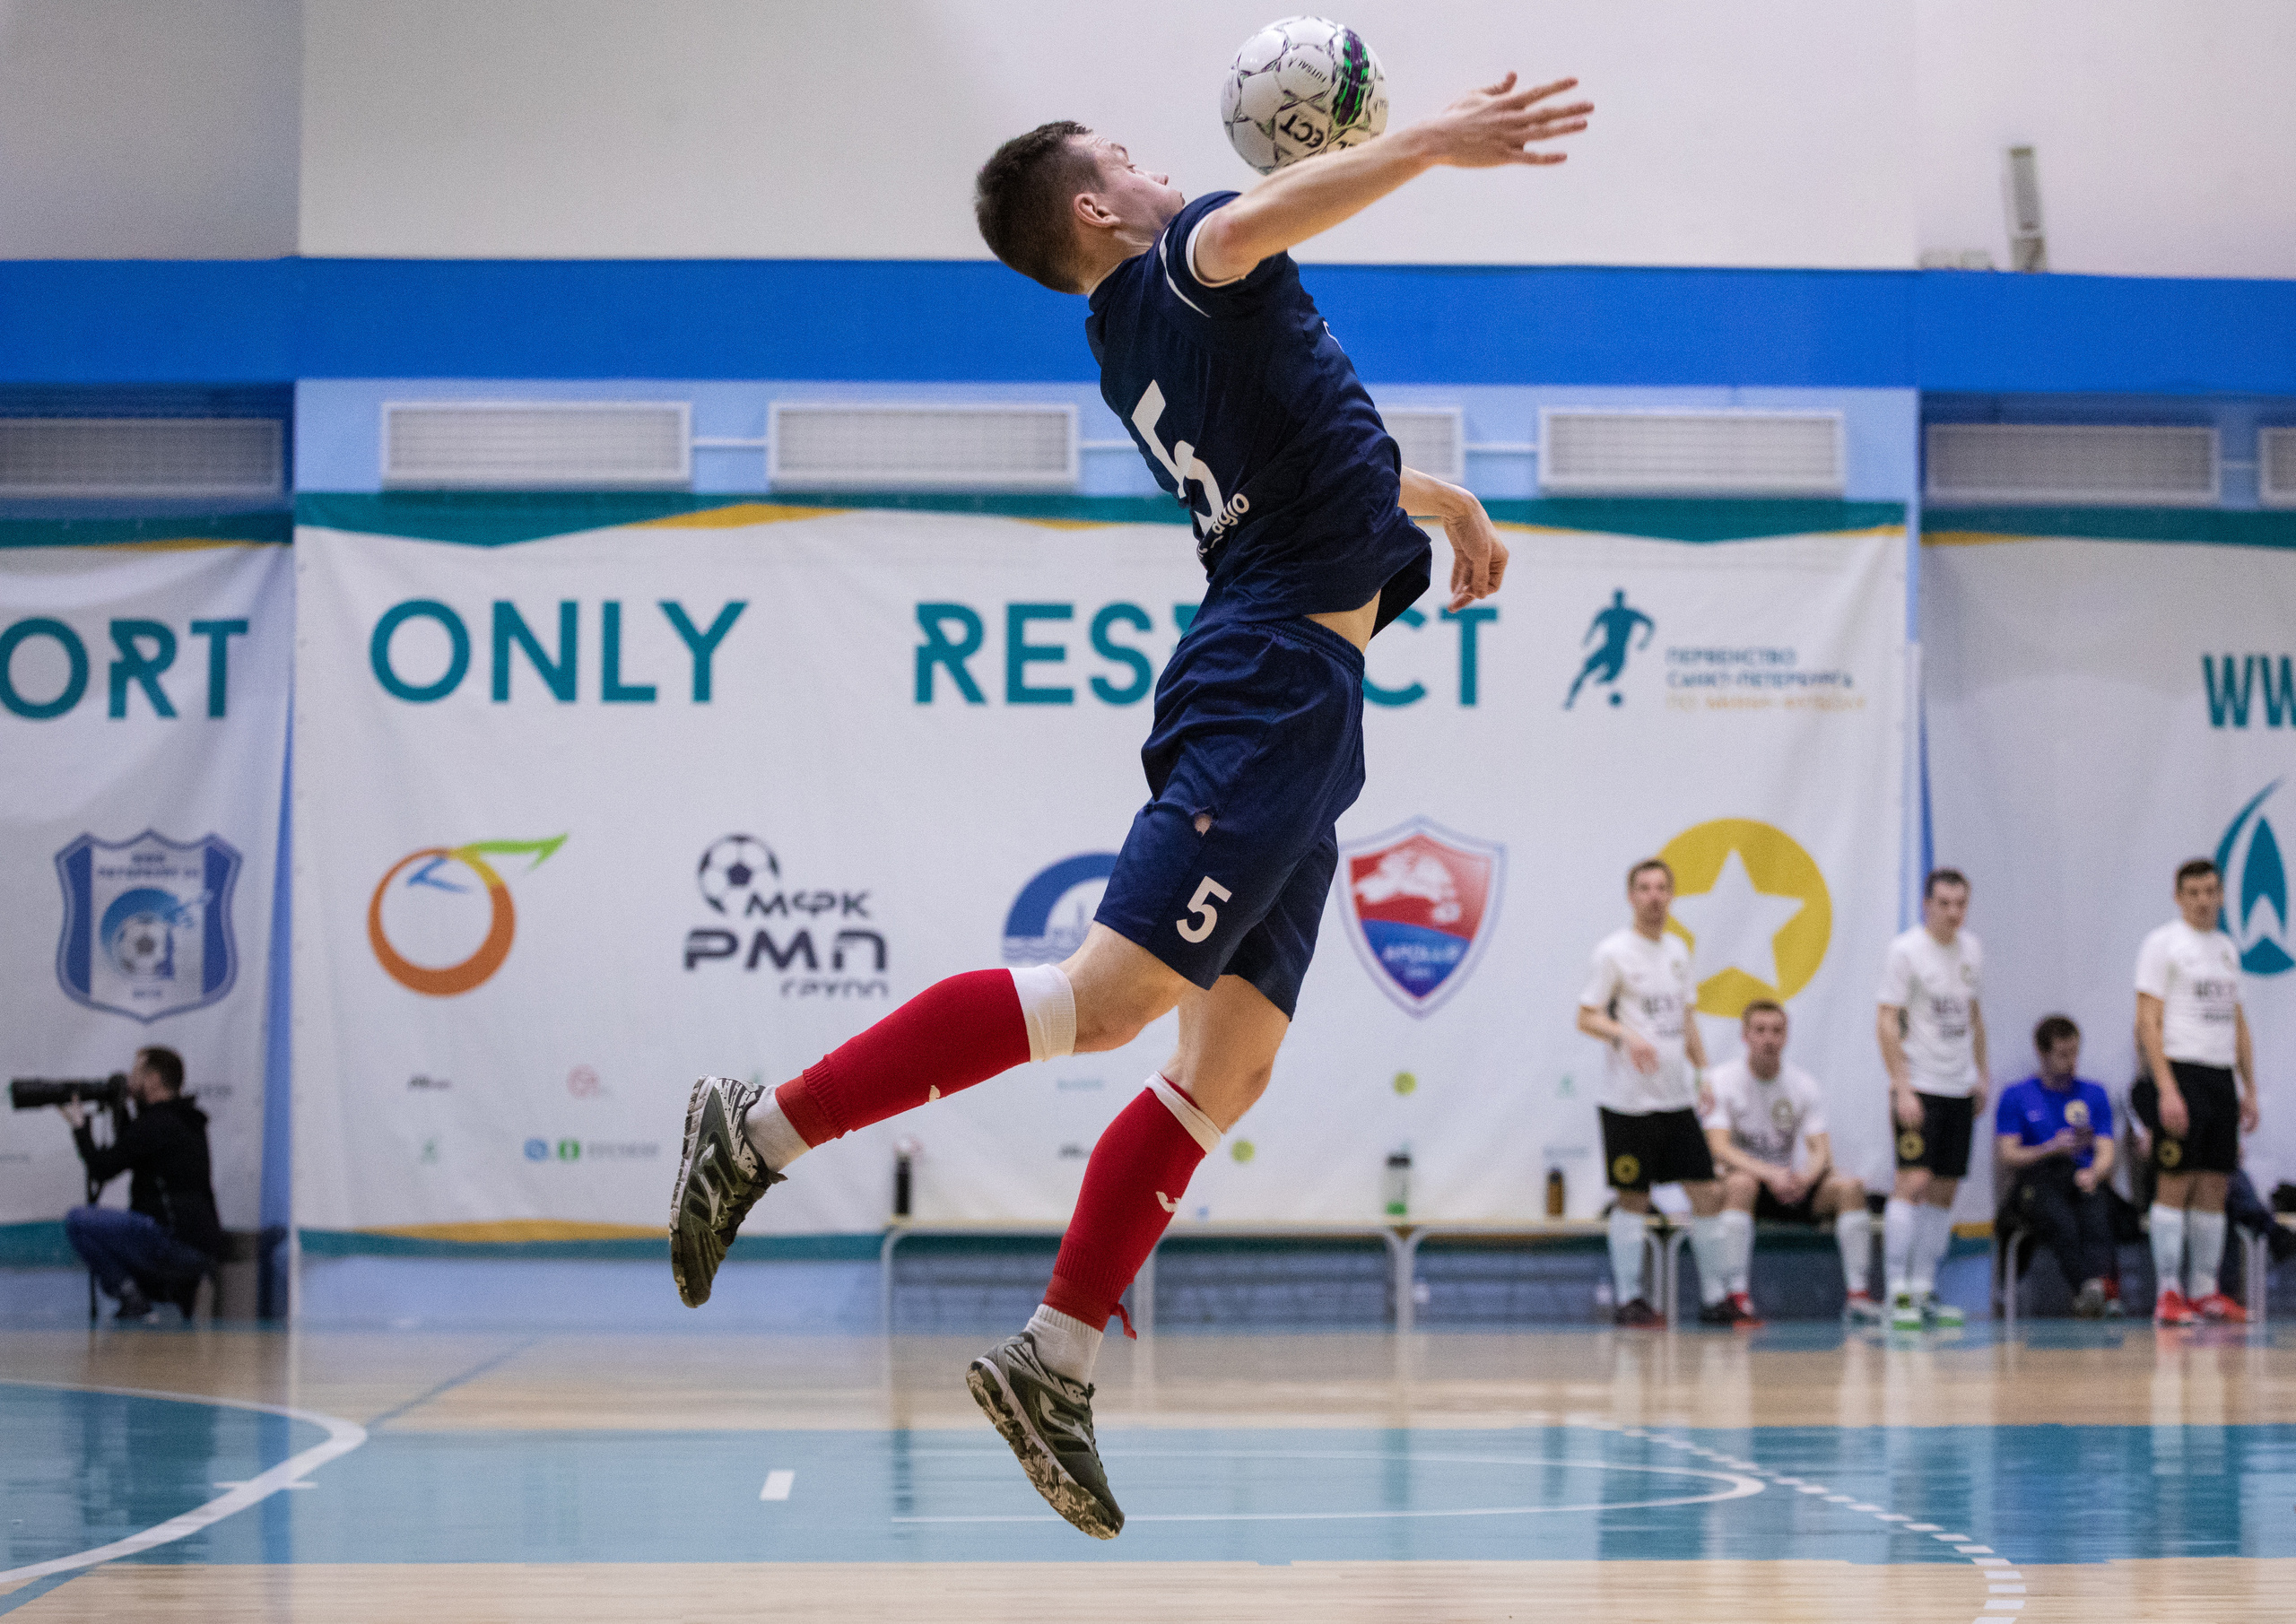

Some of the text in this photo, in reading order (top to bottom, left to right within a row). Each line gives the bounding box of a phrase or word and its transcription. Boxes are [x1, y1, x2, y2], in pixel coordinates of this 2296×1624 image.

[1131, 378, 1226, 539] 5
[370, 597, 750, 704] ONLY
[1176, 874, 1233, 943] 5
